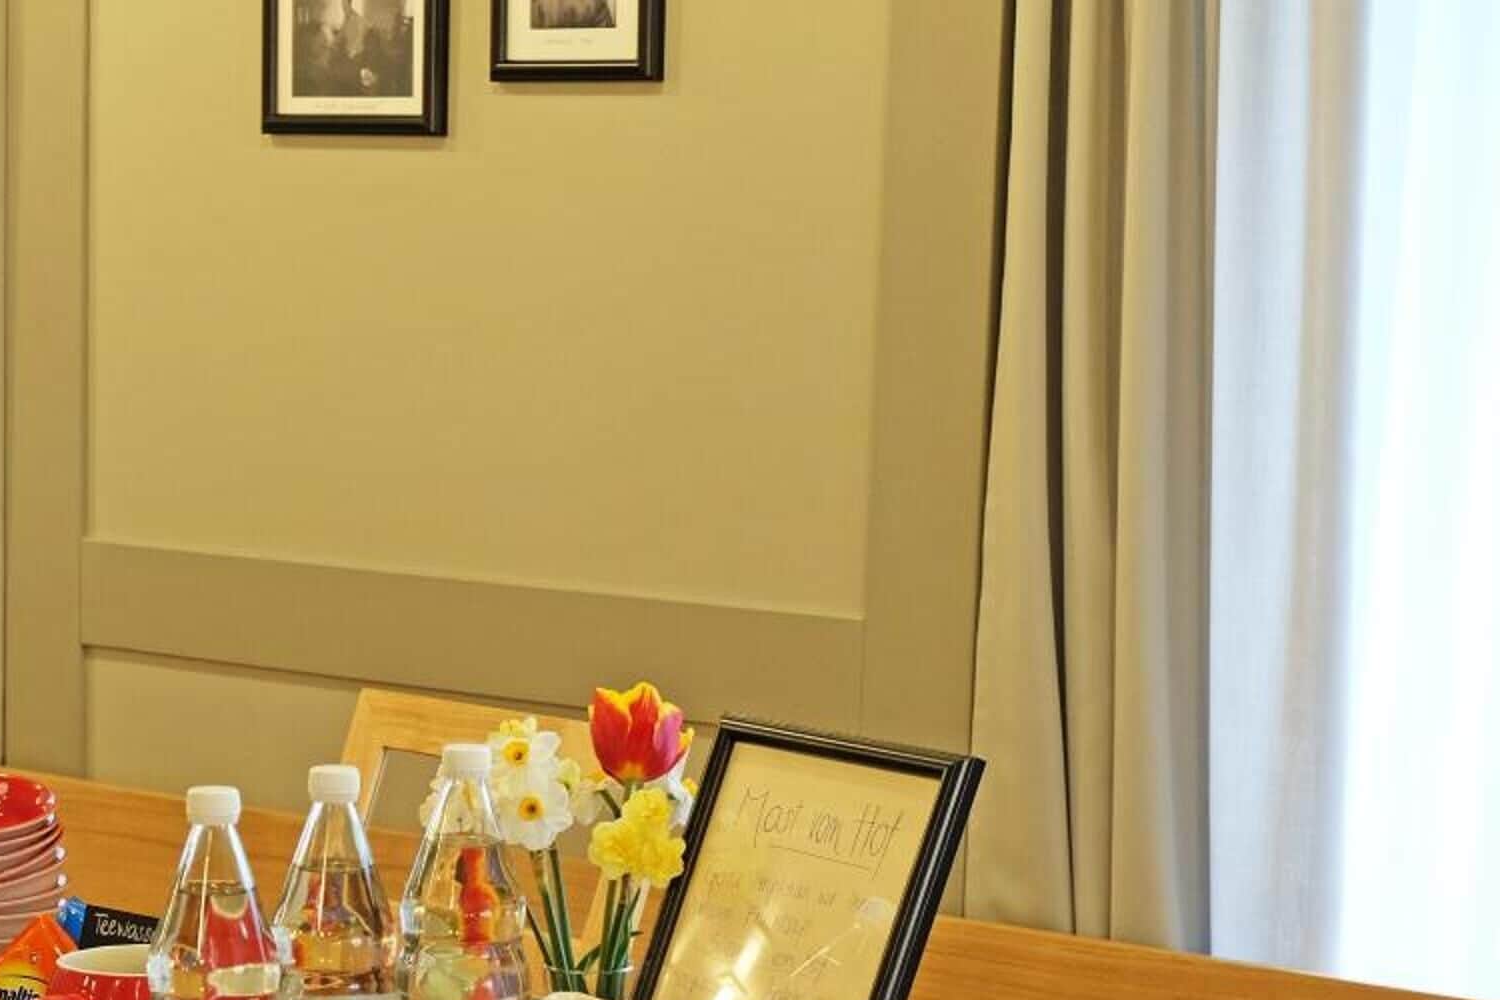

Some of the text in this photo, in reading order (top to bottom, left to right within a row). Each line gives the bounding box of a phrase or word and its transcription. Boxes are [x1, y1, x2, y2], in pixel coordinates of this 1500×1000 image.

[809, 808, 841, 855] vom
[849, 802, 904, 880] Hof
[94, 913, 158, 943] Teewass
